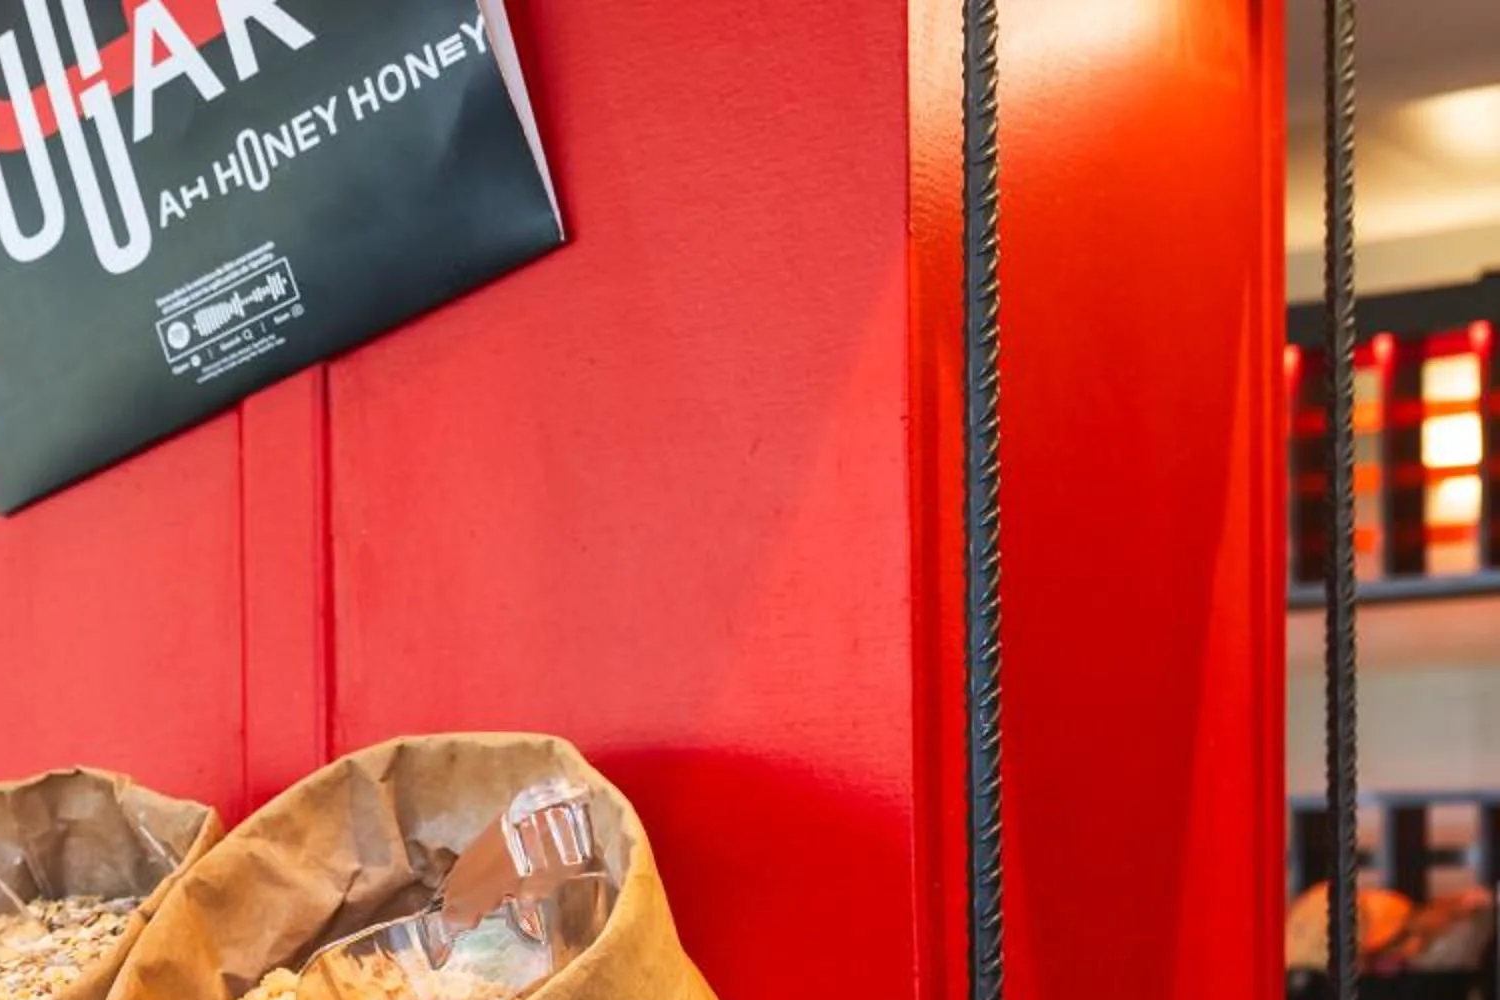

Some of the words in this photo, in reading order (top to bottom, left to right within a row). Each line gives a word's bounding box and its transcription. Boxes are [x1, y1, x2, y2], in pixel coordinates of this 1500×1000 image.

[159, 175, 209, 228] AH
[212, 96, 338, 192] HONEY
[347, 14, 487, 121] HONEY
